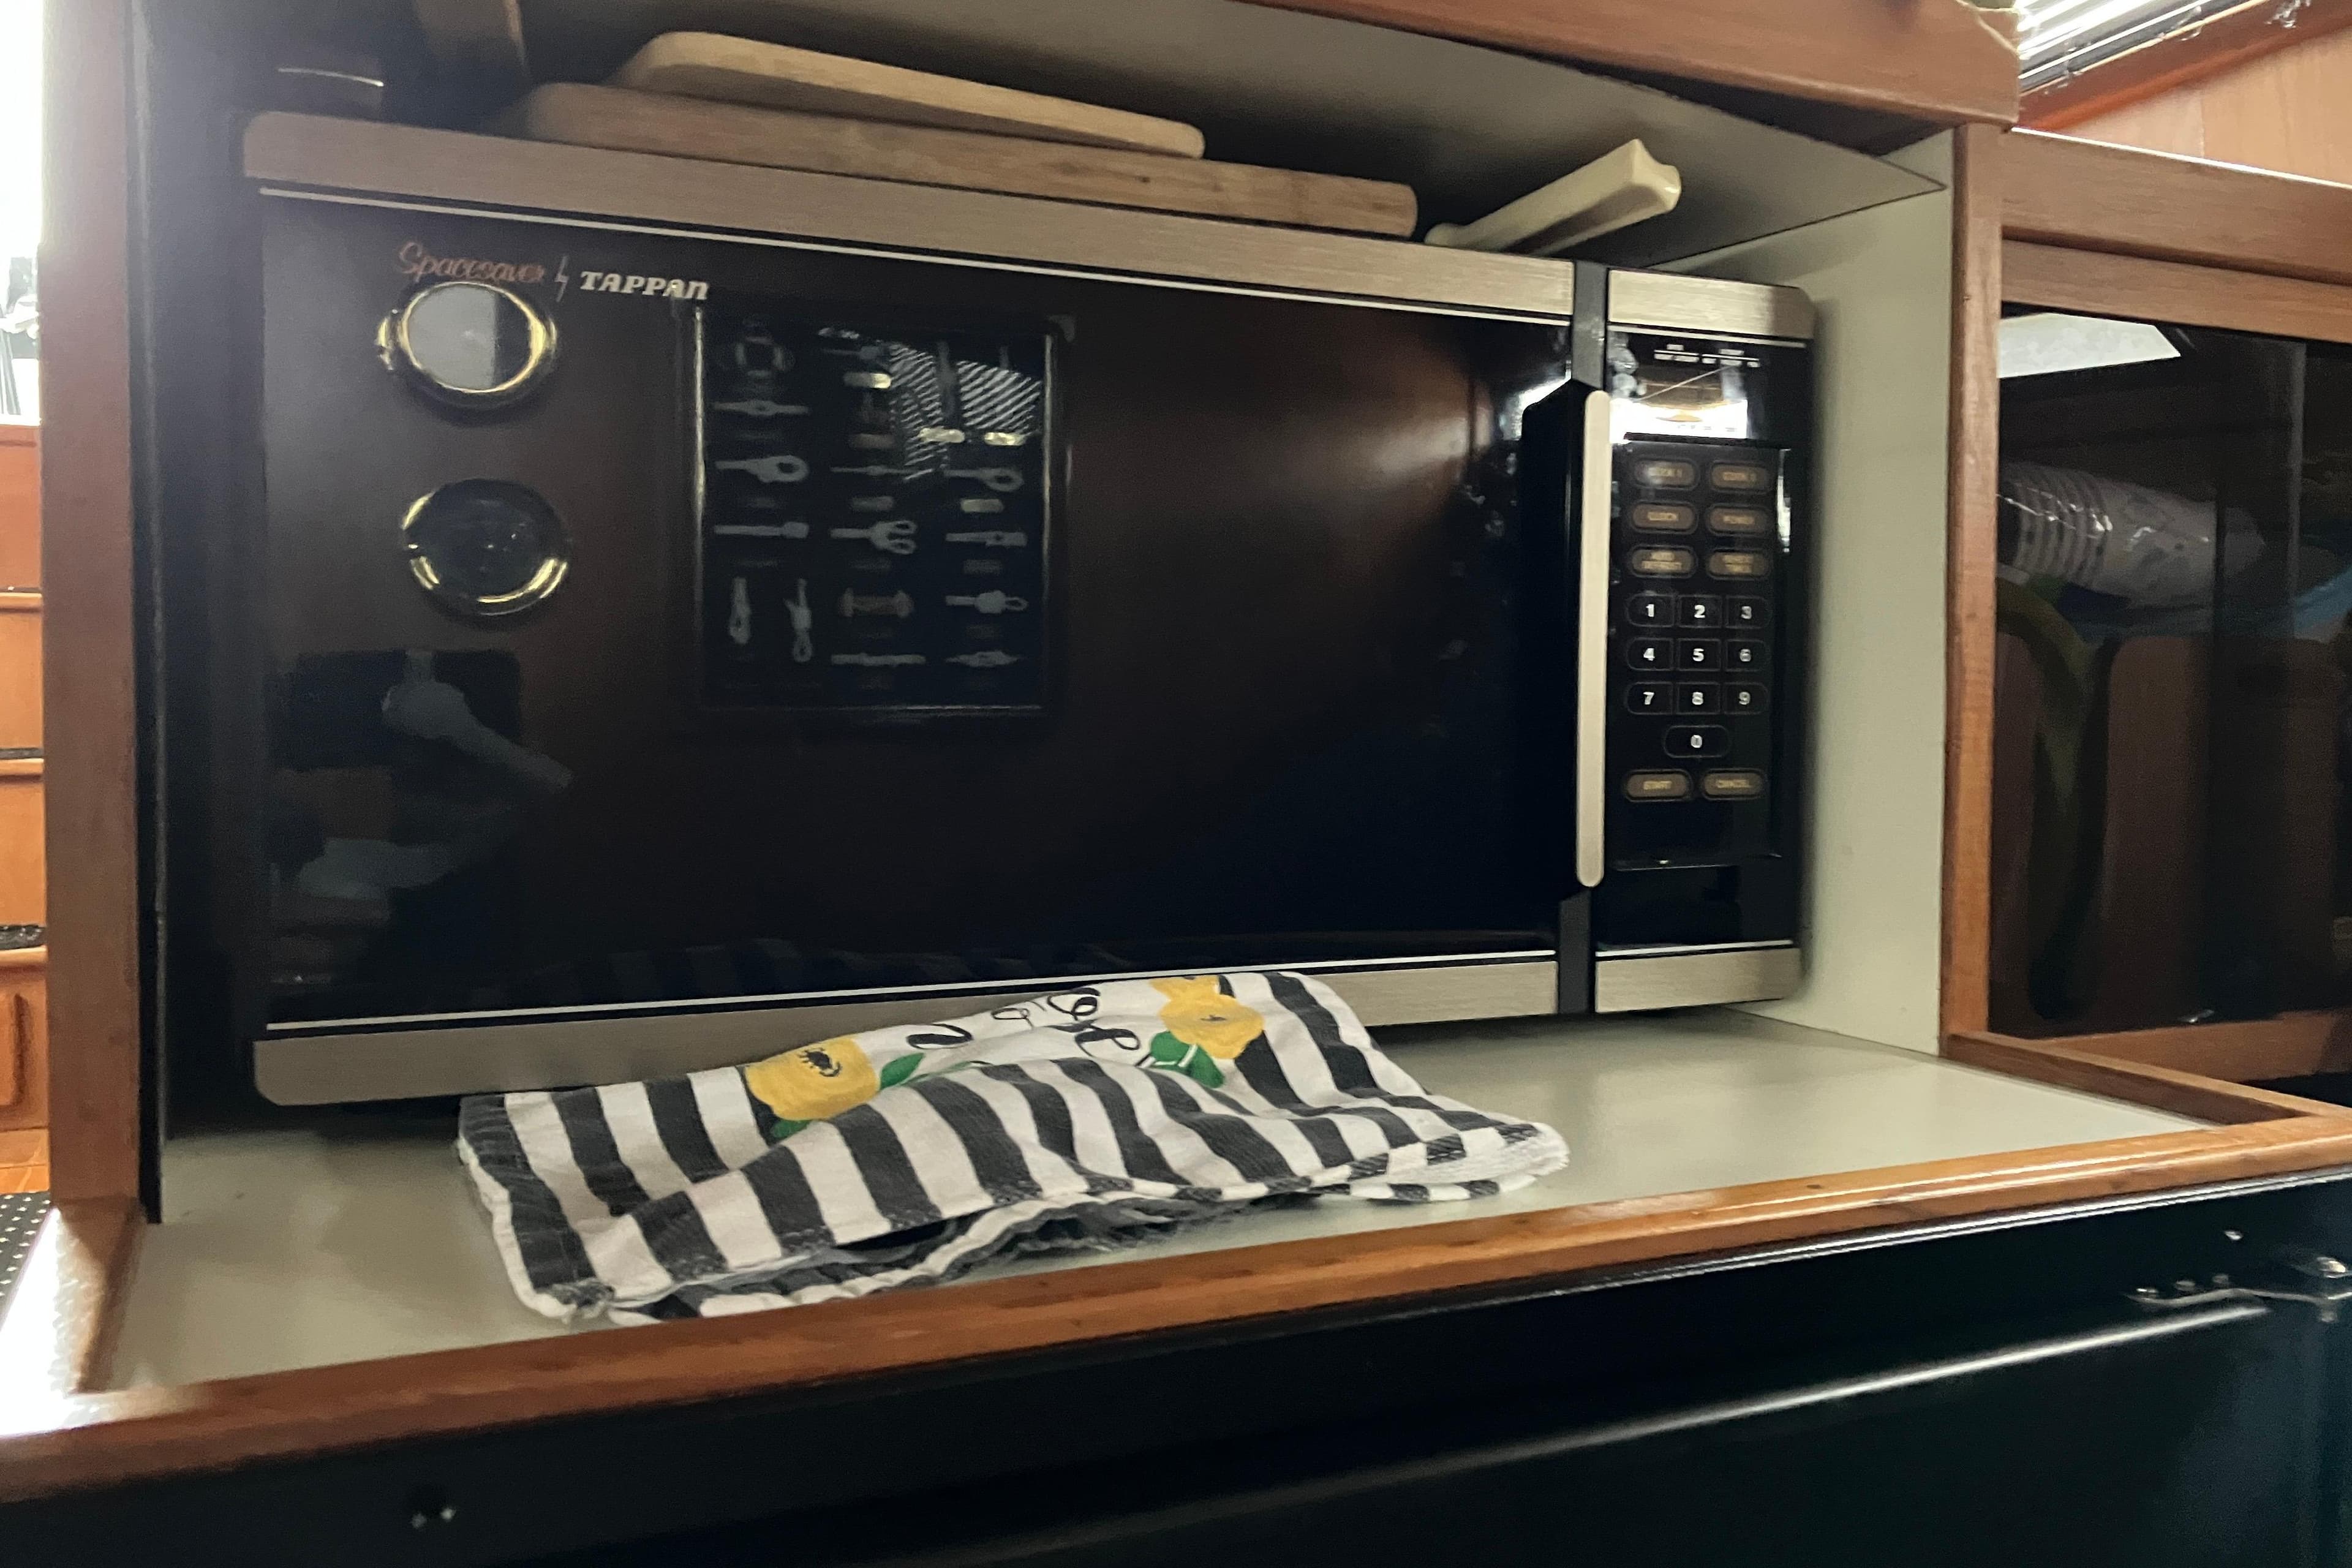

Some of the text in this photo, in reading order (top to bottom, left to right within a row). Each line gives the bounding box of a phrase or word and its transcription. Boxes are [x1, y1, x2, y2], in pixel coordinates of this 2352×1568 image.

[1645, 603, 1752, 620] 1 2 3
[1642, 647, 1752, 663] 4 5 6
[1643, 692, 1751, 706] 7 8 9
[1690, 734, 1703, 748] 0
